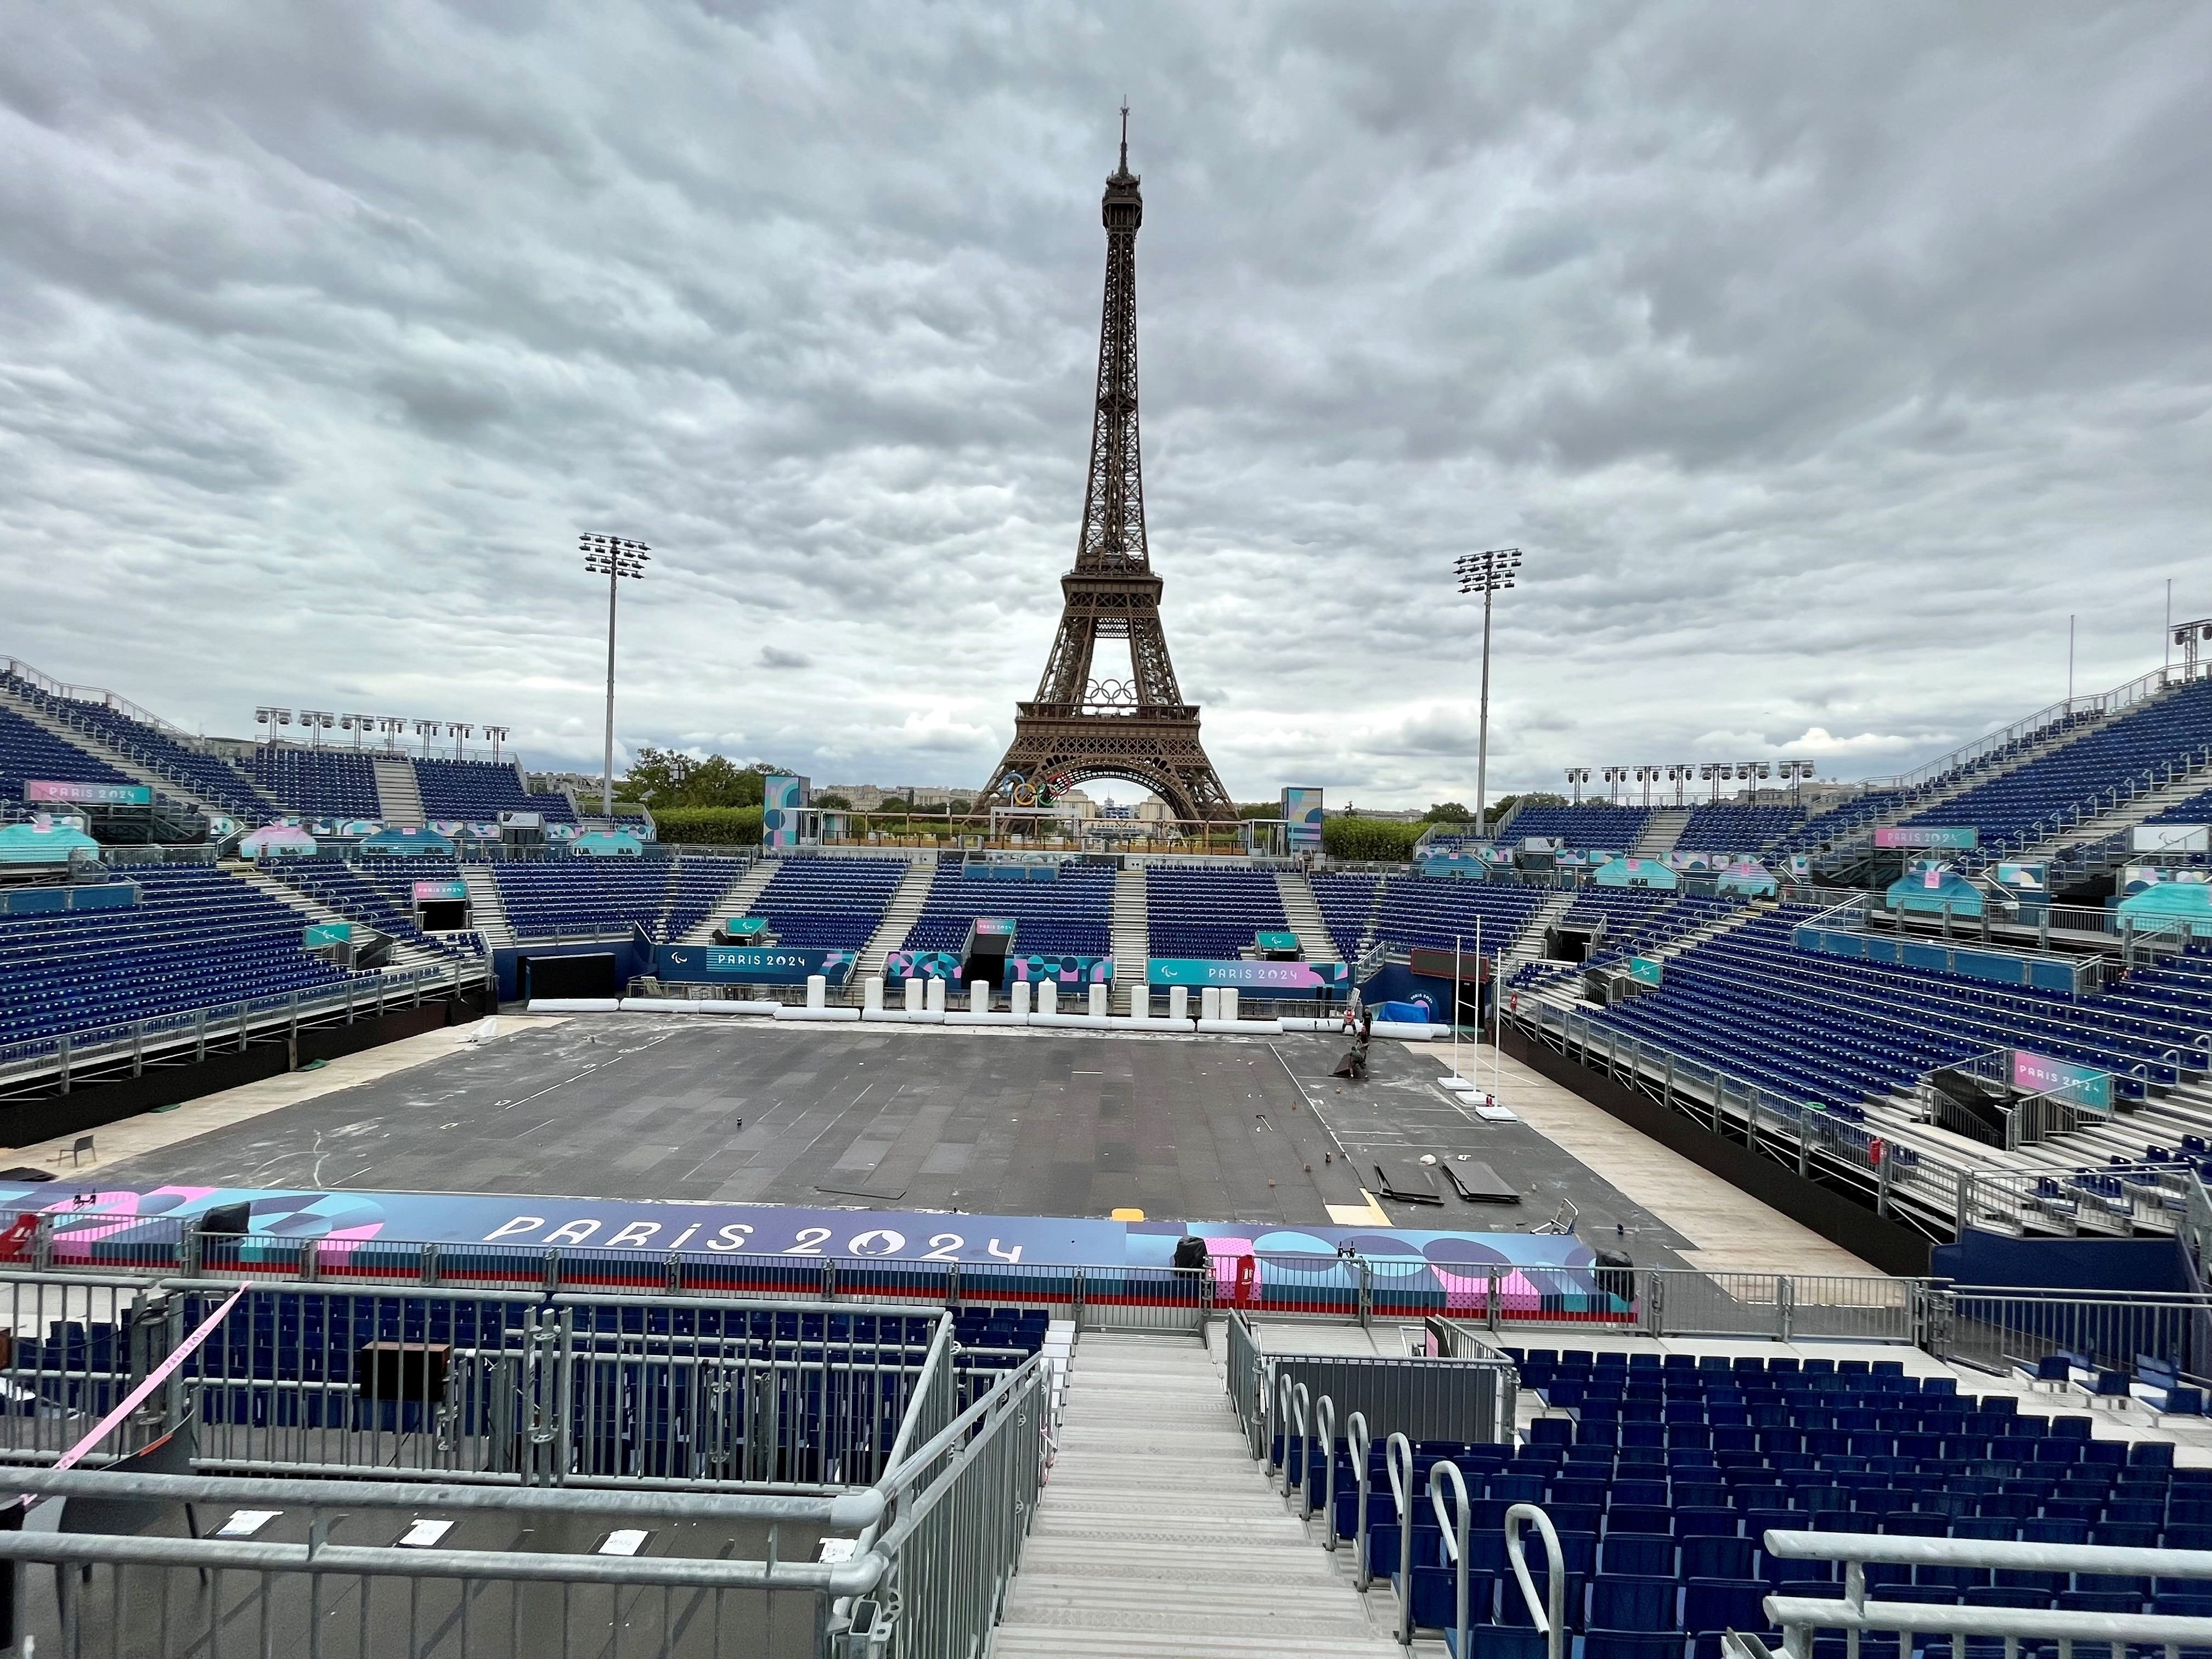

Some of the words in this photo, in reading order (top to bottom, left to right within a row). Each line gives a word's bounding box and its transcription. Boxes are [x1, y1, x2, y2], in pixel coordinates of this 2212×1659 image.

[48, 787, 93, 798] PARIS
[98, 789, 135, 799] 2024
[1887, 833, 1920, 842] PARIS
[718, 954, 760, 965] PARIS
[766, 955, 805, 967] 2024
[1209, 968, 1252, 979] PARIS
[1258, 969, 1297, 980] 2024
[2019, 1065, 2058, 1082] PARIS
[781, 1227, 1024, 1264] 2024
